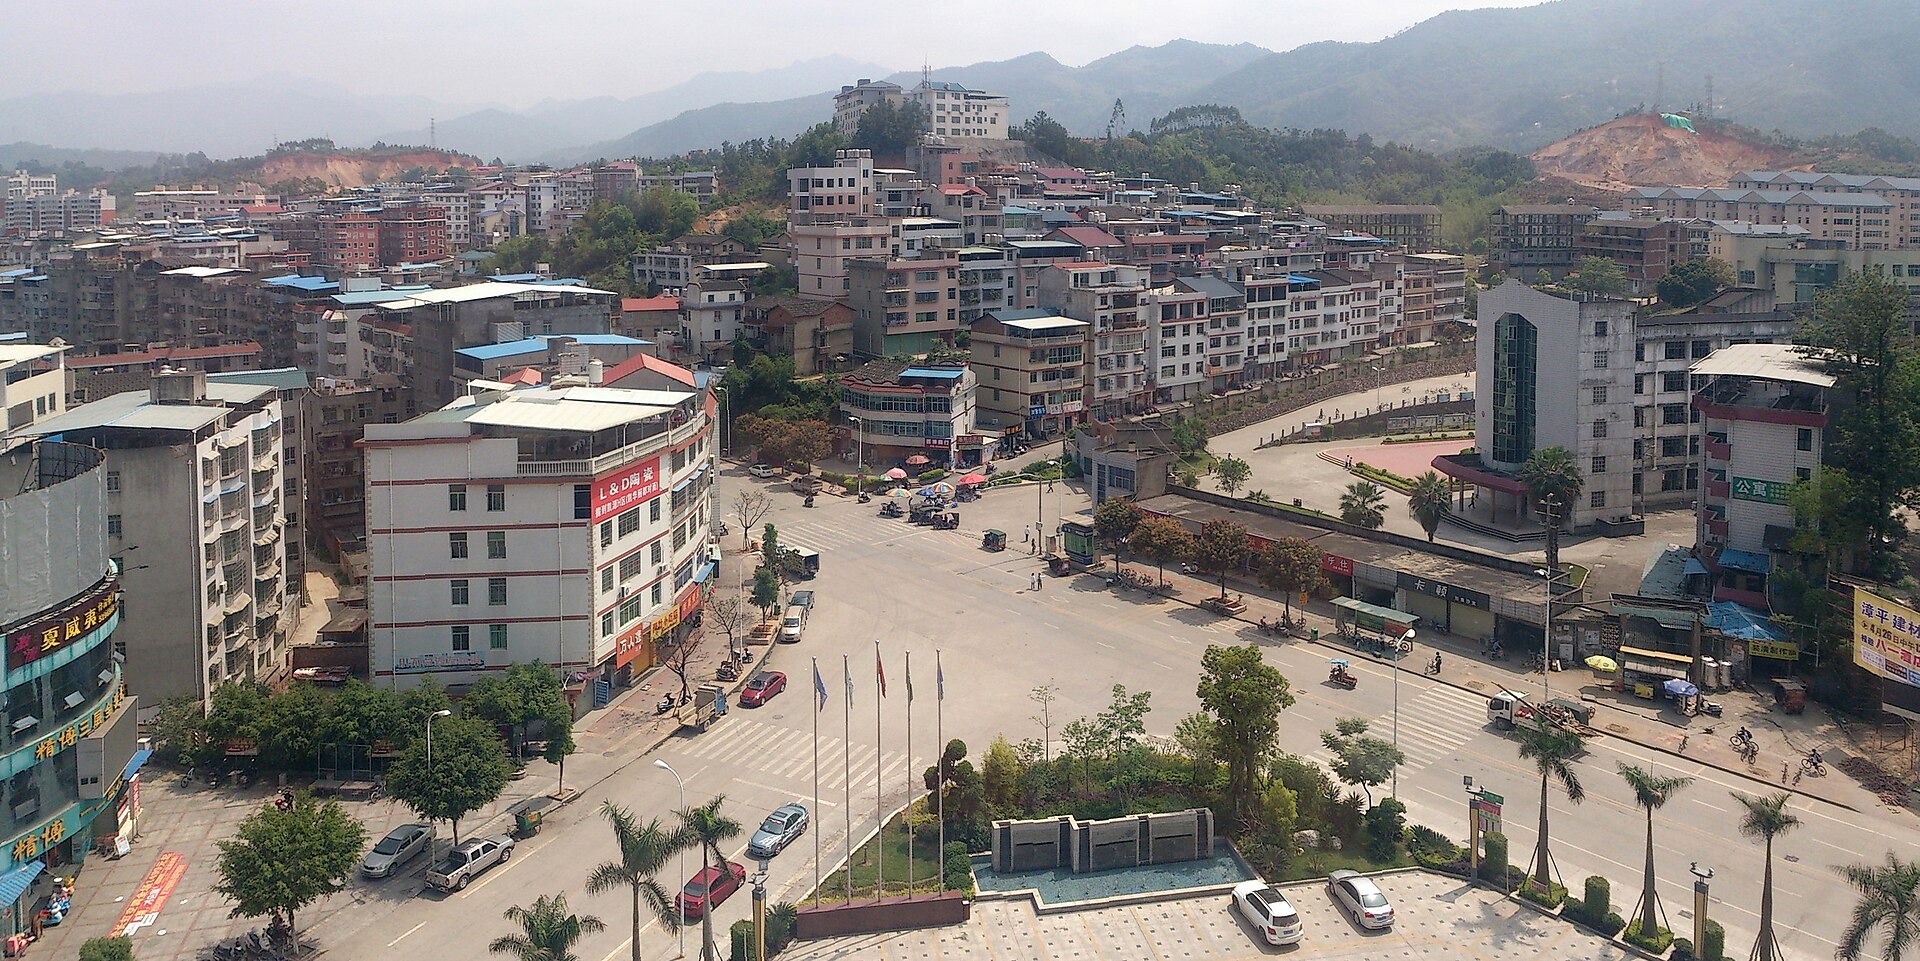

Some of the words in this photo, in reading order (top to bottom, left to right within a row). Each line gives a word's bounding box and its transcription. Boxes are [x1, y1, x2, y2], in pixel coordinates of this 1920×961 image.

[1736, 479, 1767, 497] 公寓
[41, 608, 97, 651] 夏威夷
[1861, 601, 1920, 638] 漳平建材
[13, 818, 66, 861] 精博
